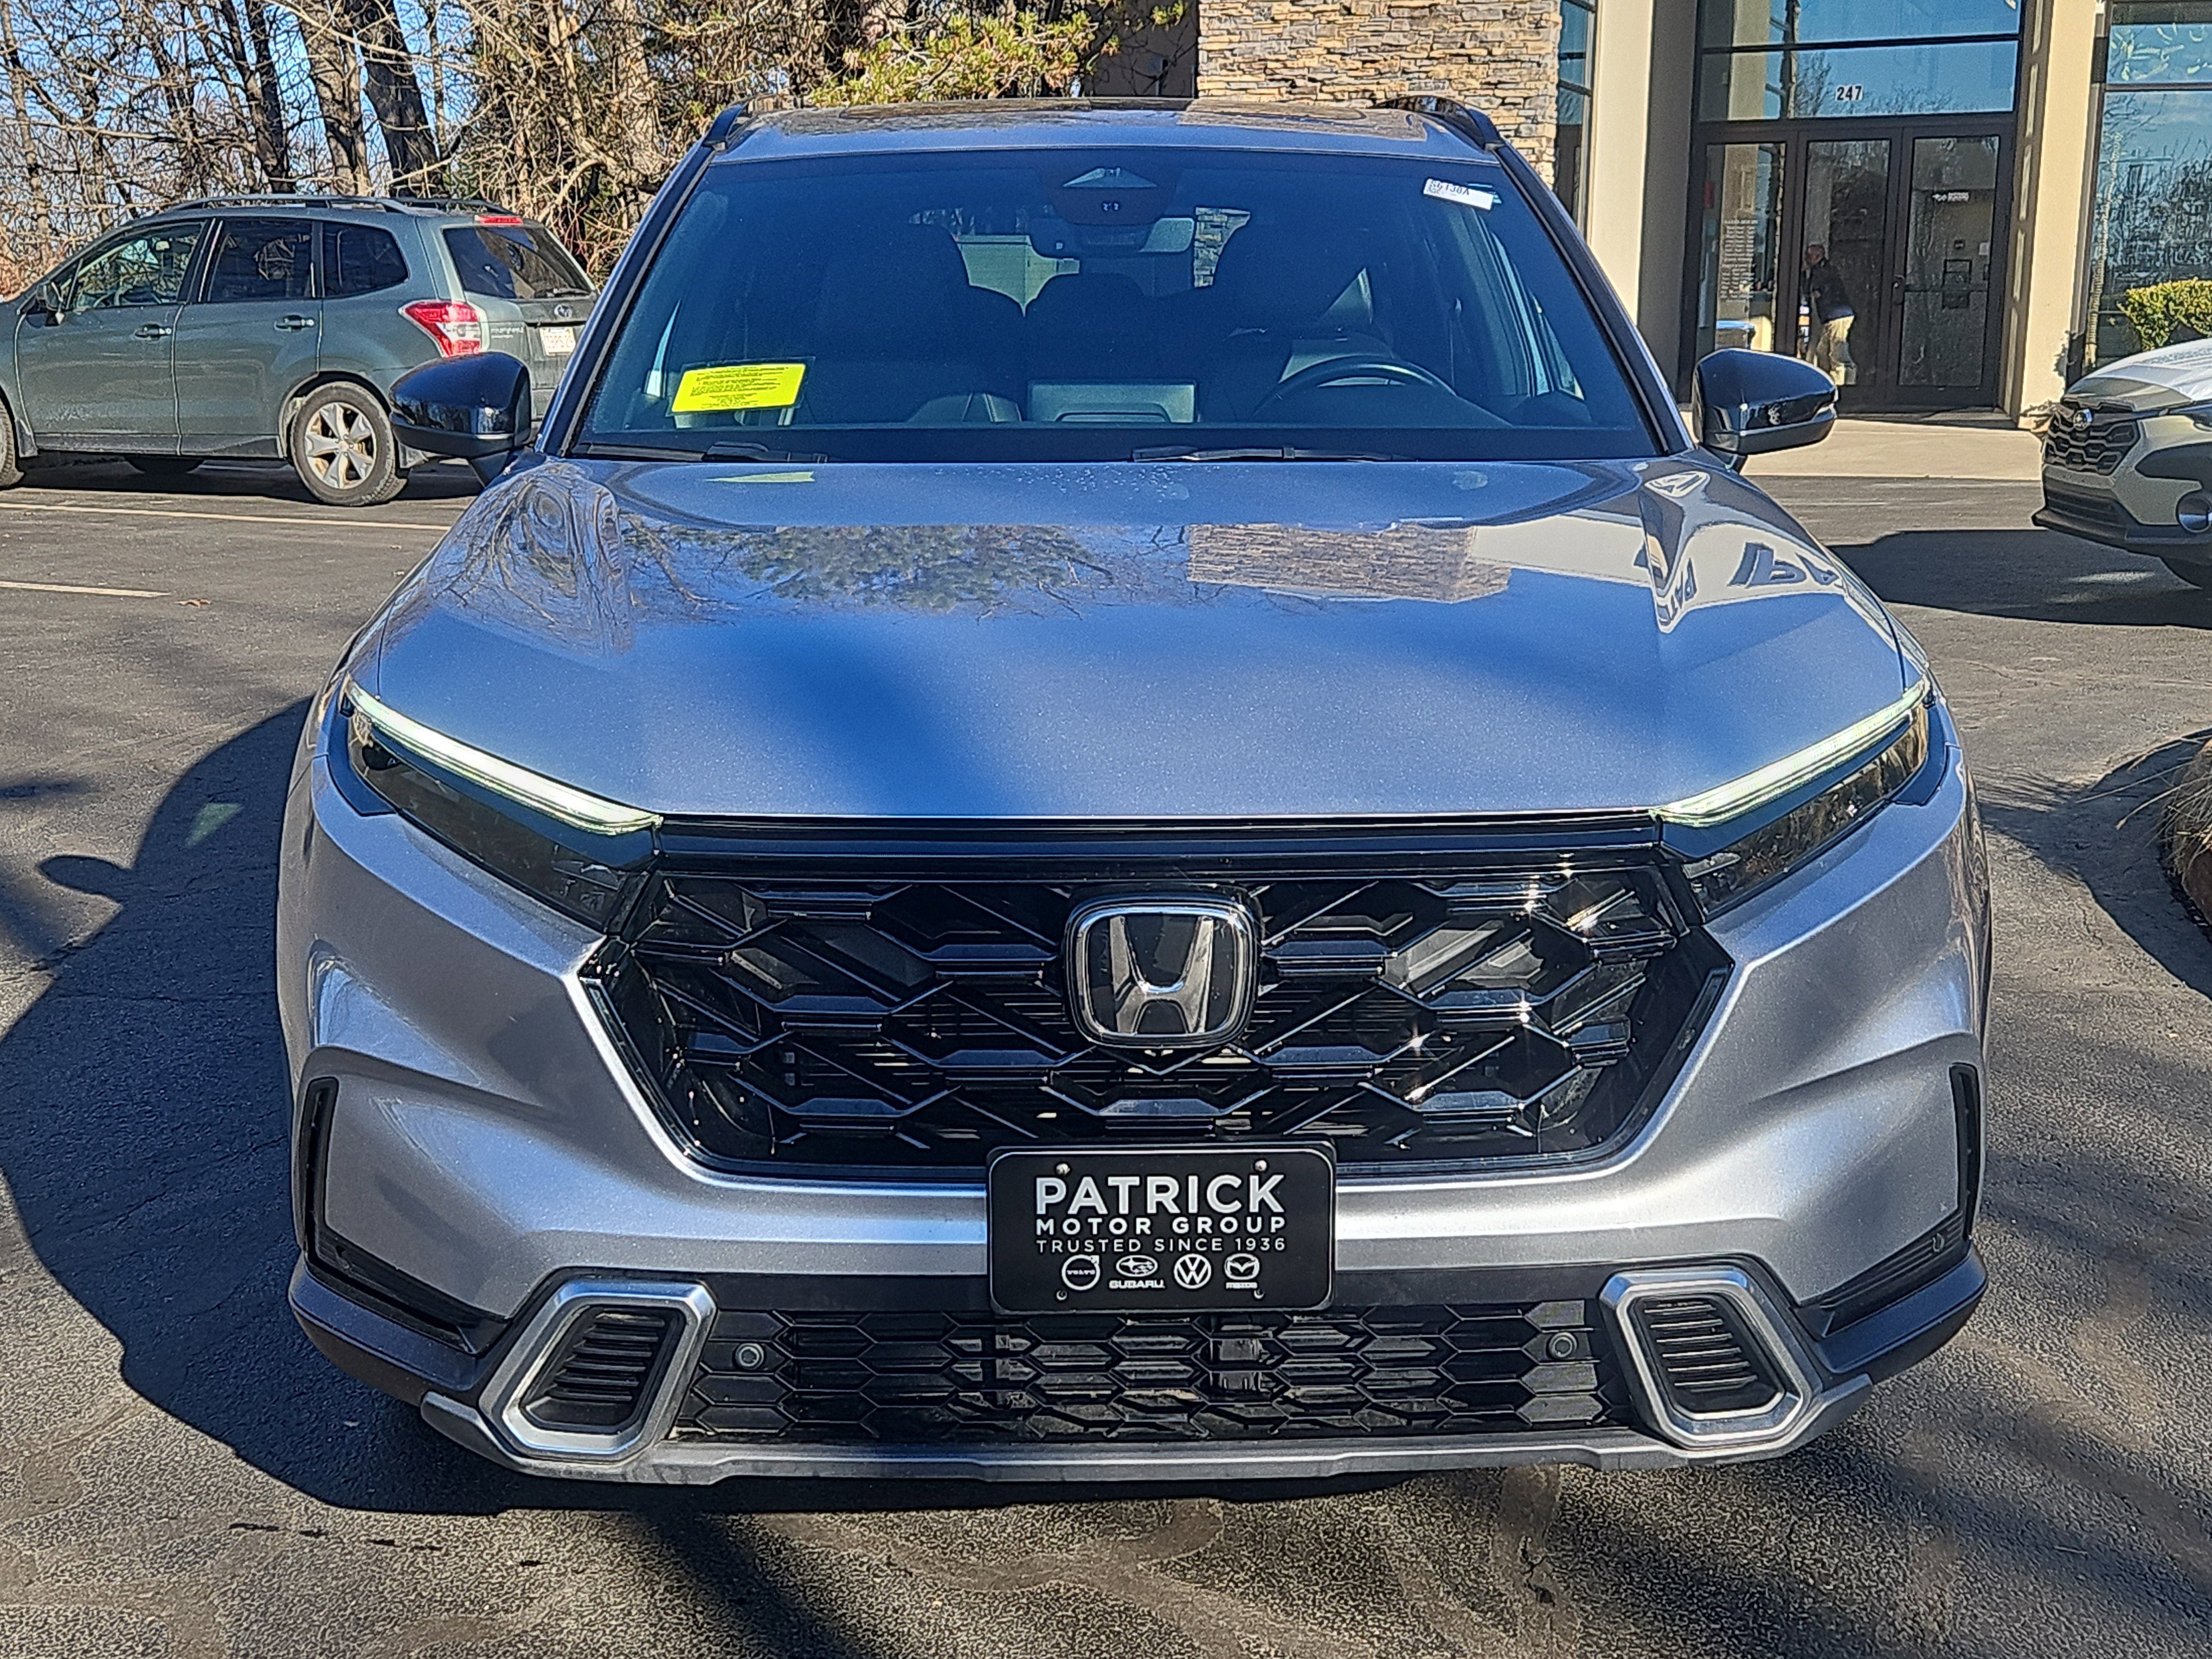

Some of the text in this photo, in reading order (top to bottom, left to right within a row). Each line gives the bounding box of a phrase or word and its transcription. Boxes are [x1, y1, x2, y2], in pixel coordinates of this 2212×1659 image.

[1837, 85, 1862, 101] 247
[1036, 1174, 1284, 1214] PATRICK
[1036, 1217, 1285, 1236] MOTOR GROUP
[1036, 1238, 1285, 1253] TRUSTED SINCE 1936
[1109, 1279, 1165, 1289] SUBARU
